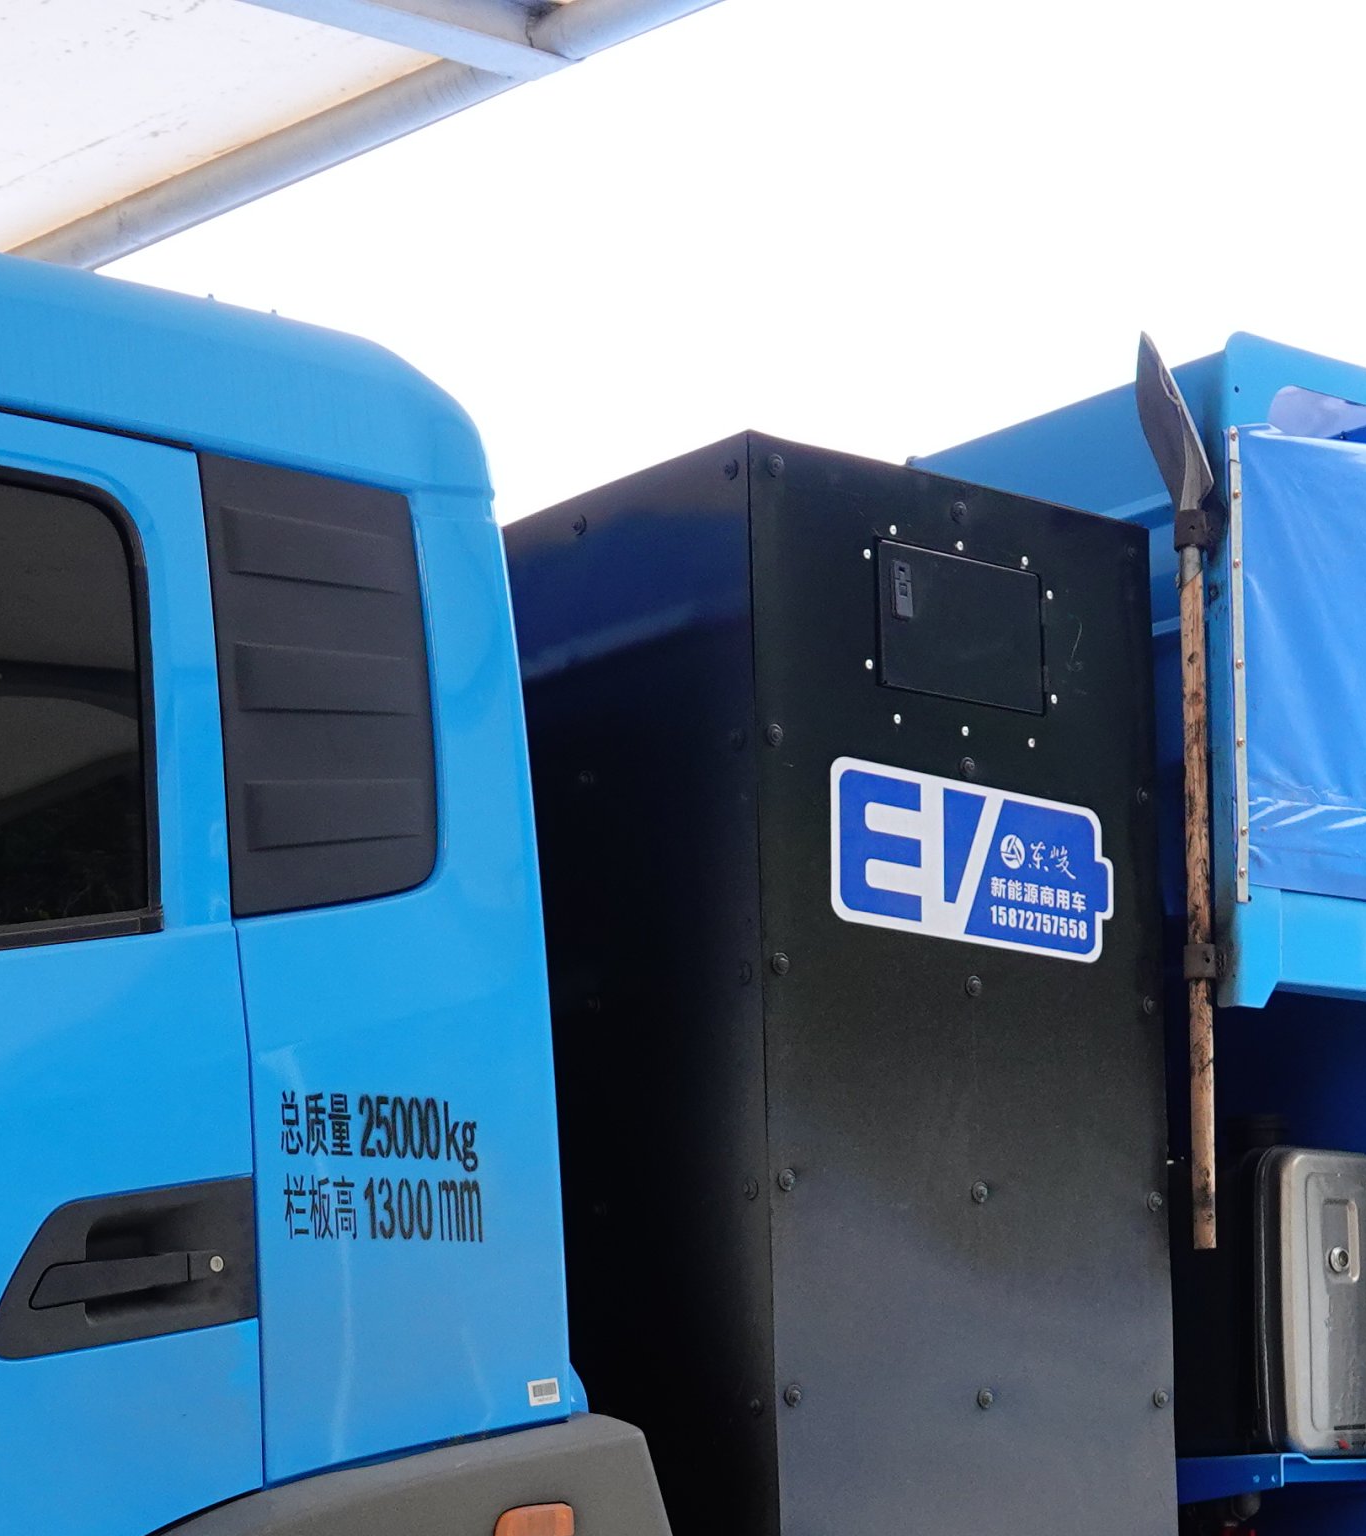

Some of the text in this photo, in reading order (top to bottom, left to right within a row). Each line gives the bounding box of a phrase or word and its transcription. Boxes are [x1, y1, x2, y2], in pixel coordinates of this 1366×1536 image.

[839, 768, 1005, 934] EV
[990, 876, 1086, 913] 新能源商用车
[990, 905, 1088, 941] 15872757558
[280, 1089, 353, 1158] 总质量
[283, 1172, 358, 1241] 栏板高
